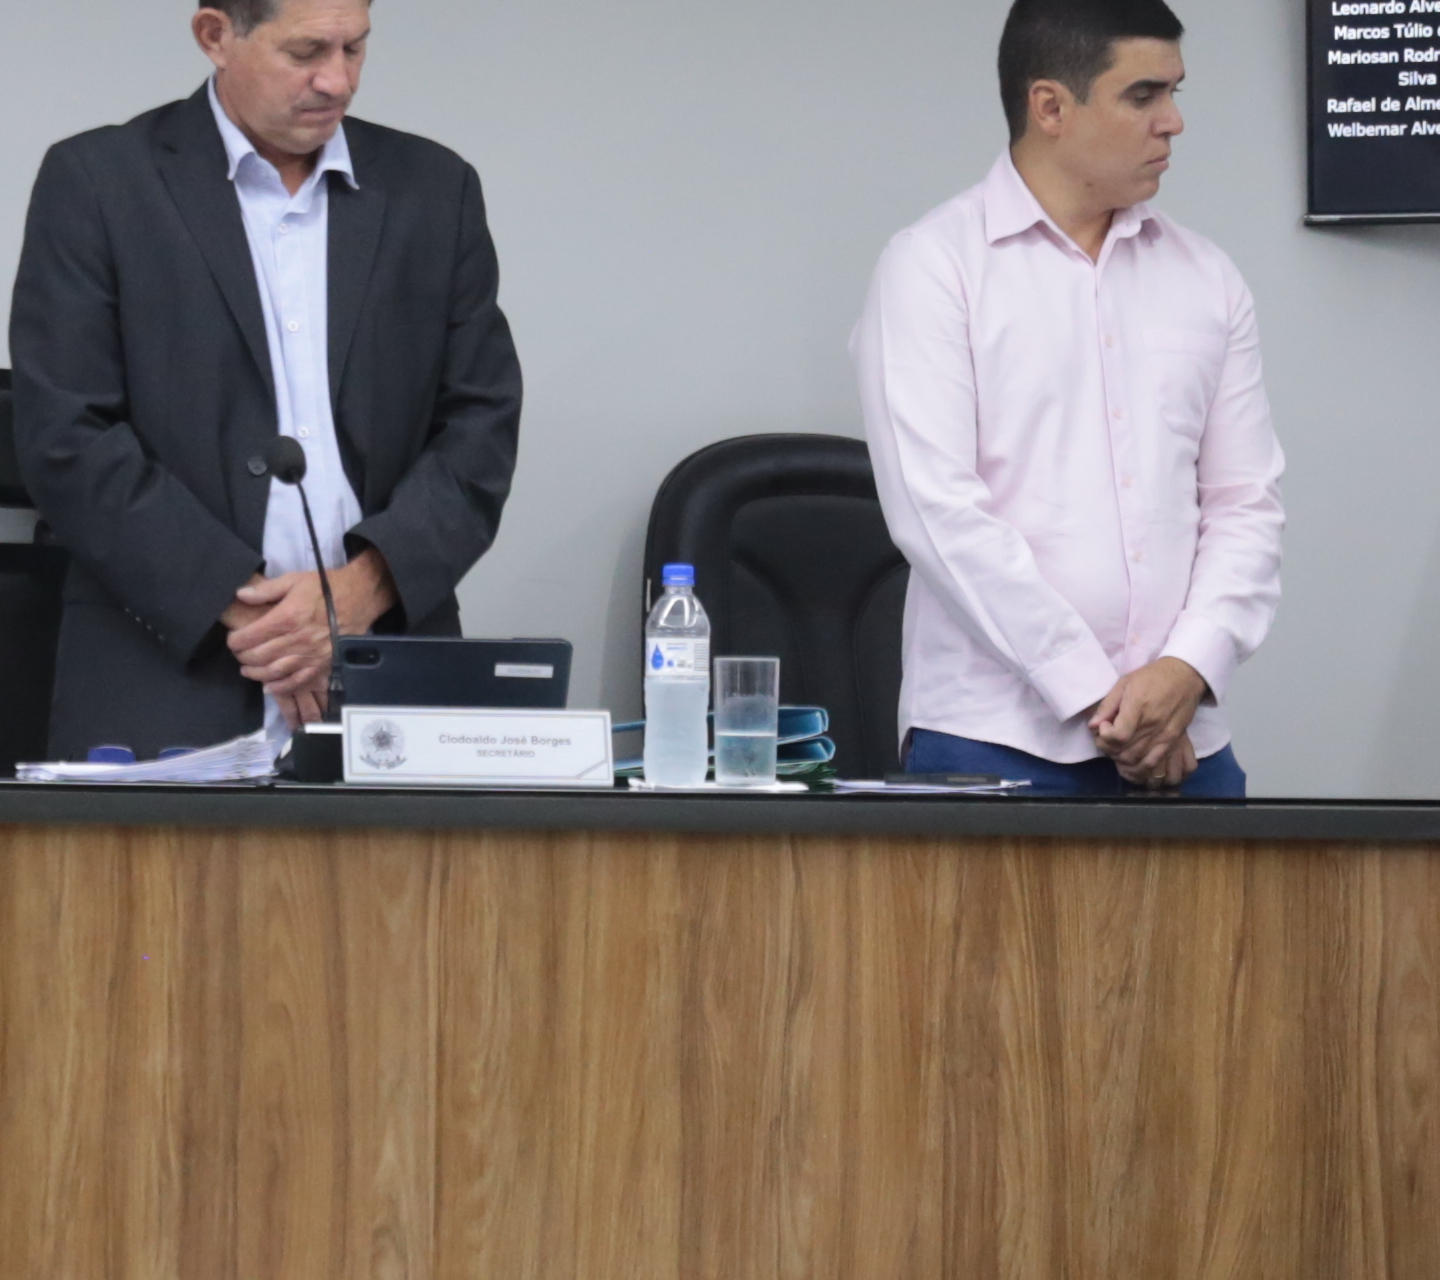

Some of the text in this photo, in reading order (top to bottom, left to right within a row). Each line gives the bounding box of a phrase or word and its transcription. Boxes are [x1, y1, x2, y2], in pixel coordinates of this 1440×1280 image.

[1332, 0, 1405, 16] Leonardo
[1334, 25, 1390, 40] Marcos
[1393, 22, 1433, 38] Túlio
[1328, 50, 1399, 64] Mariosan
[1399, 71, 1437, 86] Silva
[1327, 98, 1376, 113] Rafael
[1381, 97, 1400, 111] de
[1328, 122, 1407, 137] Welbemar
[439, 735, 571, 747] Clodoaldo José Borges
